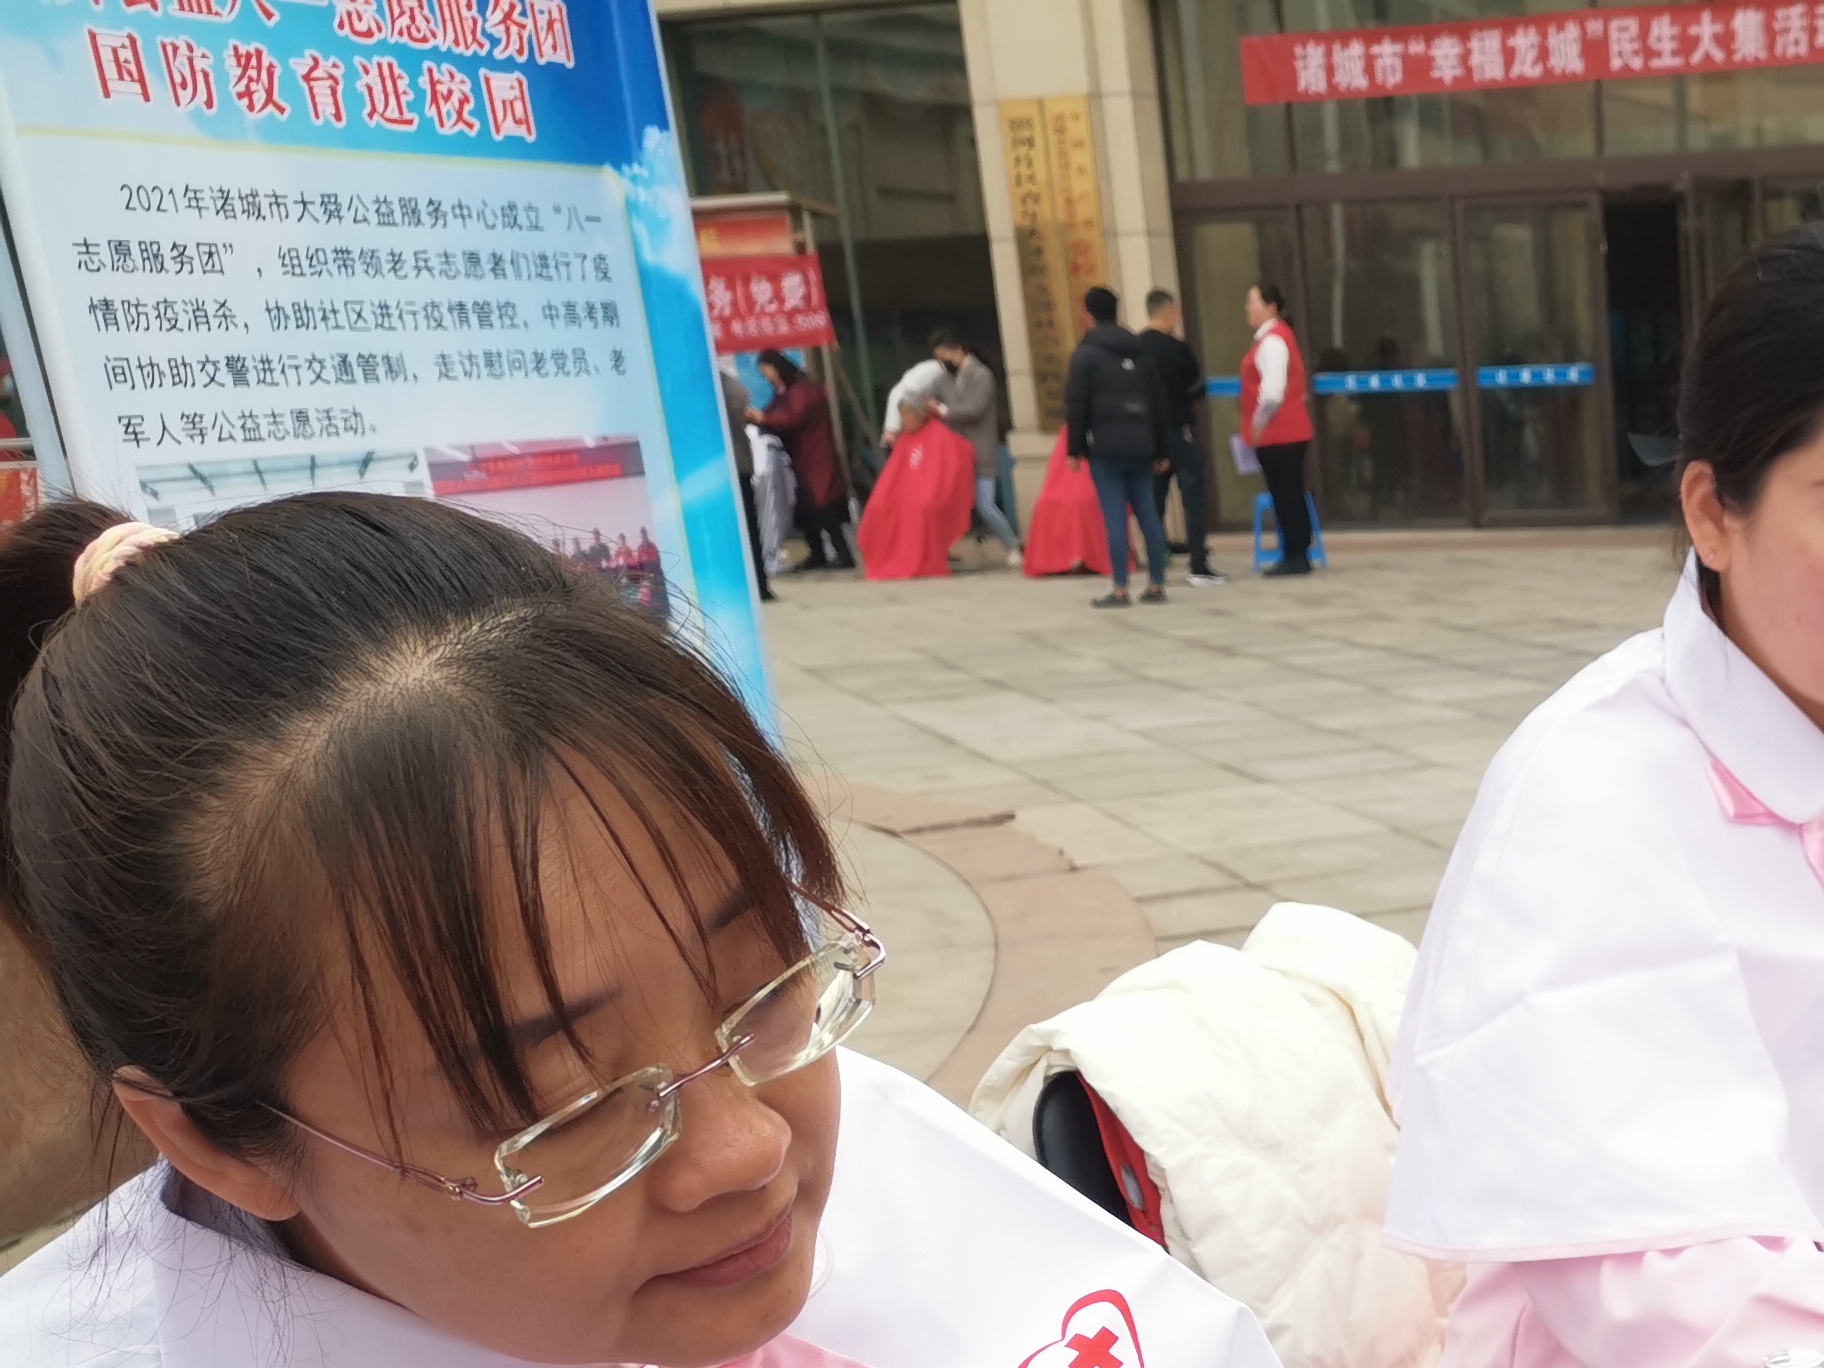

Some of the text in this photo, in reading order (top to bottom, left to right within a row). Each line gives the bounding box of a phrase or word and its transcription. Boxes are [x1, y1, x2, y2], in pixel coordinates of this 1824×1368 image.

[87, 28, 536, 139] 国防教育进校园
[117, 406, 378, 448] 军人等公益志愿活动。
